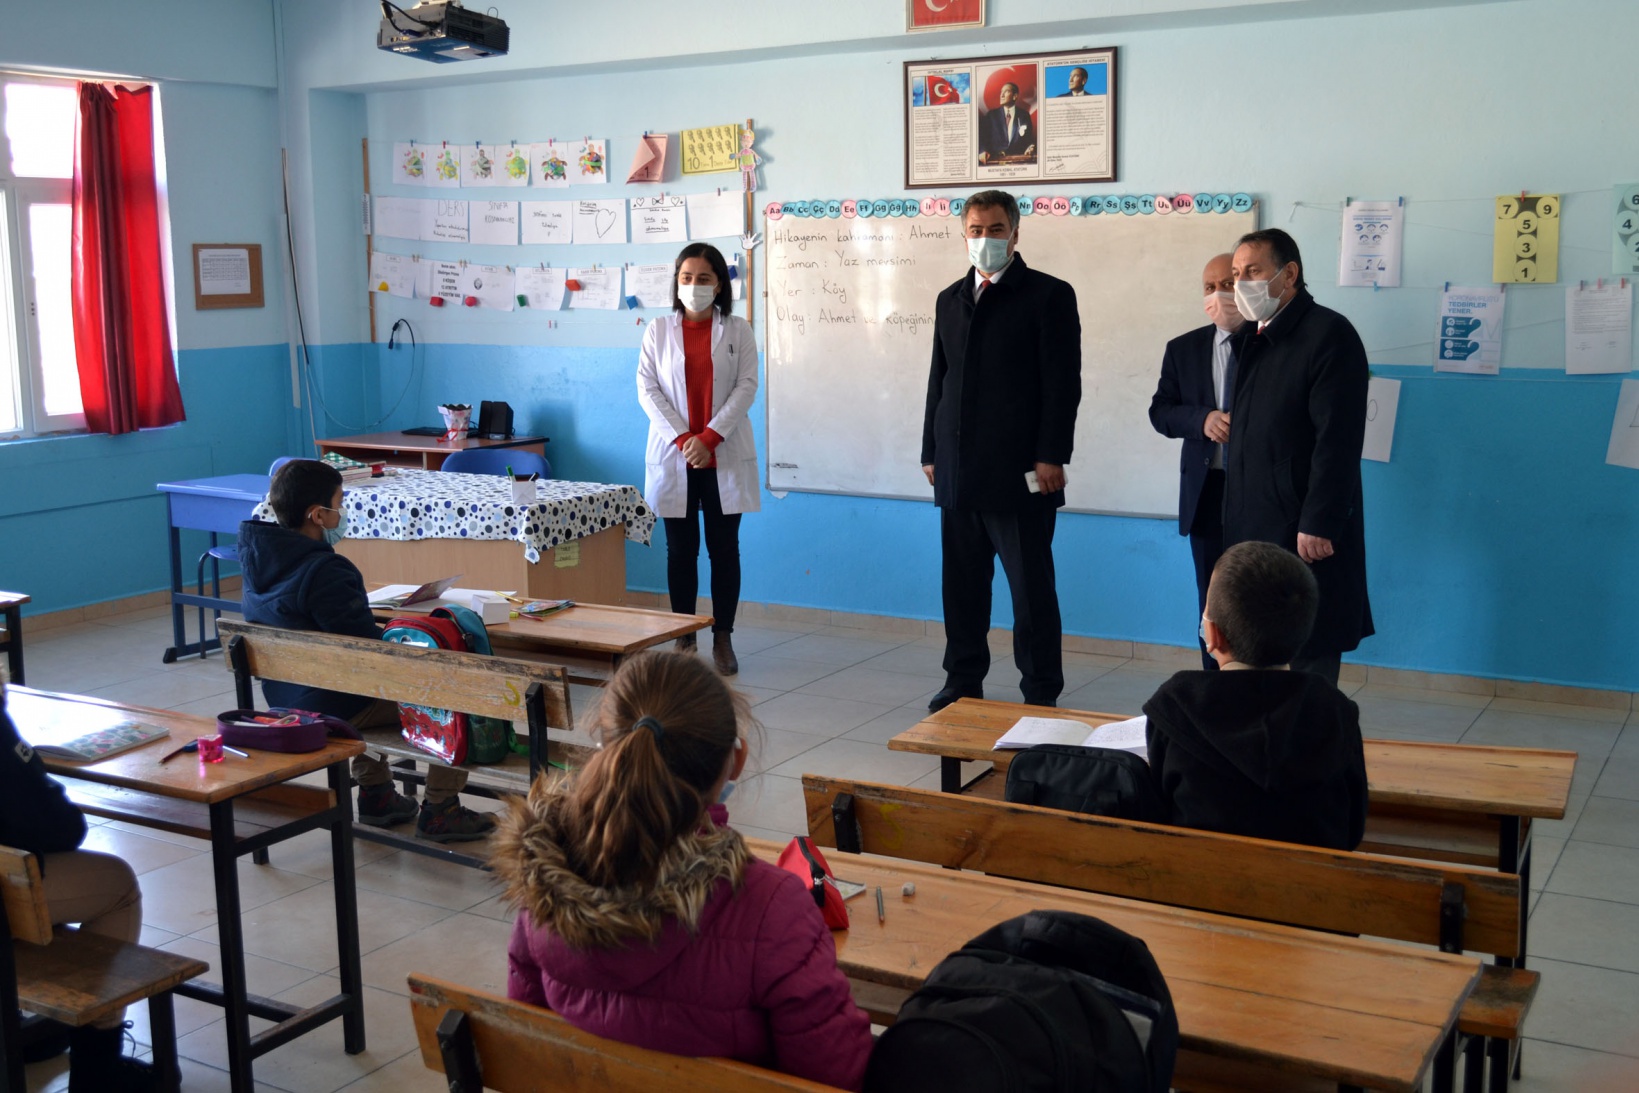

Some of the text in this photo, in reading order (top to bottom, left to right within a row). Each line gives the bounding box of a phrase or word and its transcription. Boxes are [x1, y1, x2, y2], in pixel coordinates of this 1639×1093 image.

[687, 157, 700, 170] 10
[1502, 204, 1552, 215] 7 9
[1522, 219, 1531, 230] 5
[1622, 219, 1632, 230] 4
[774, 229, 828, 250] Hikayenin
[909, 225, 951, 240] Ahmet
[1521, 242, 1531, 253] 3
[835, 250, 859, 267] Yaz
[1521, 267, 1529, 278] 1
[777, 279, 803, 297] Yer
[822, 279, 847, 304] Köy
[818, 308, 857, 324] Ahmet
